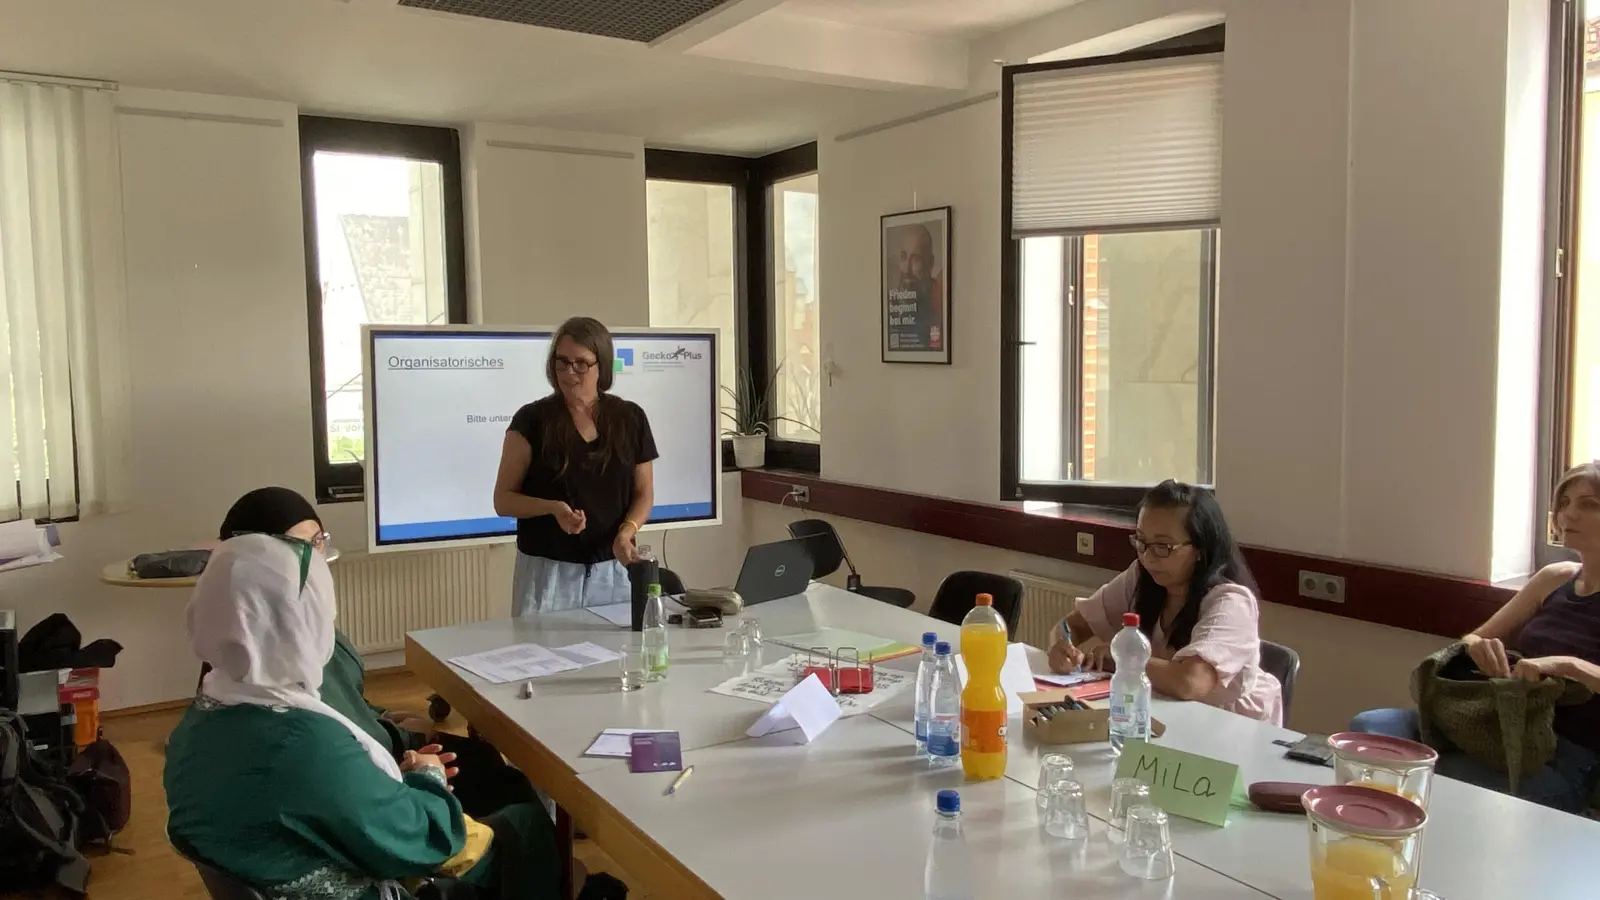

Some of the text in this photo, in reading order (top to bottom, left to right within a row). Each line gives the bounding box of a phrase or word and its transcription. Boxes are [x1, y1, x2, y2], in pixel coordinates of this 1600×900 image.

[642, 351, 702, 360] Gecko Plus
[388, 356, 504, 370] Organisatorisches
[466, 414, 513, 423] Bitte unter
[1132, 754, 1217, 798] MiLa
